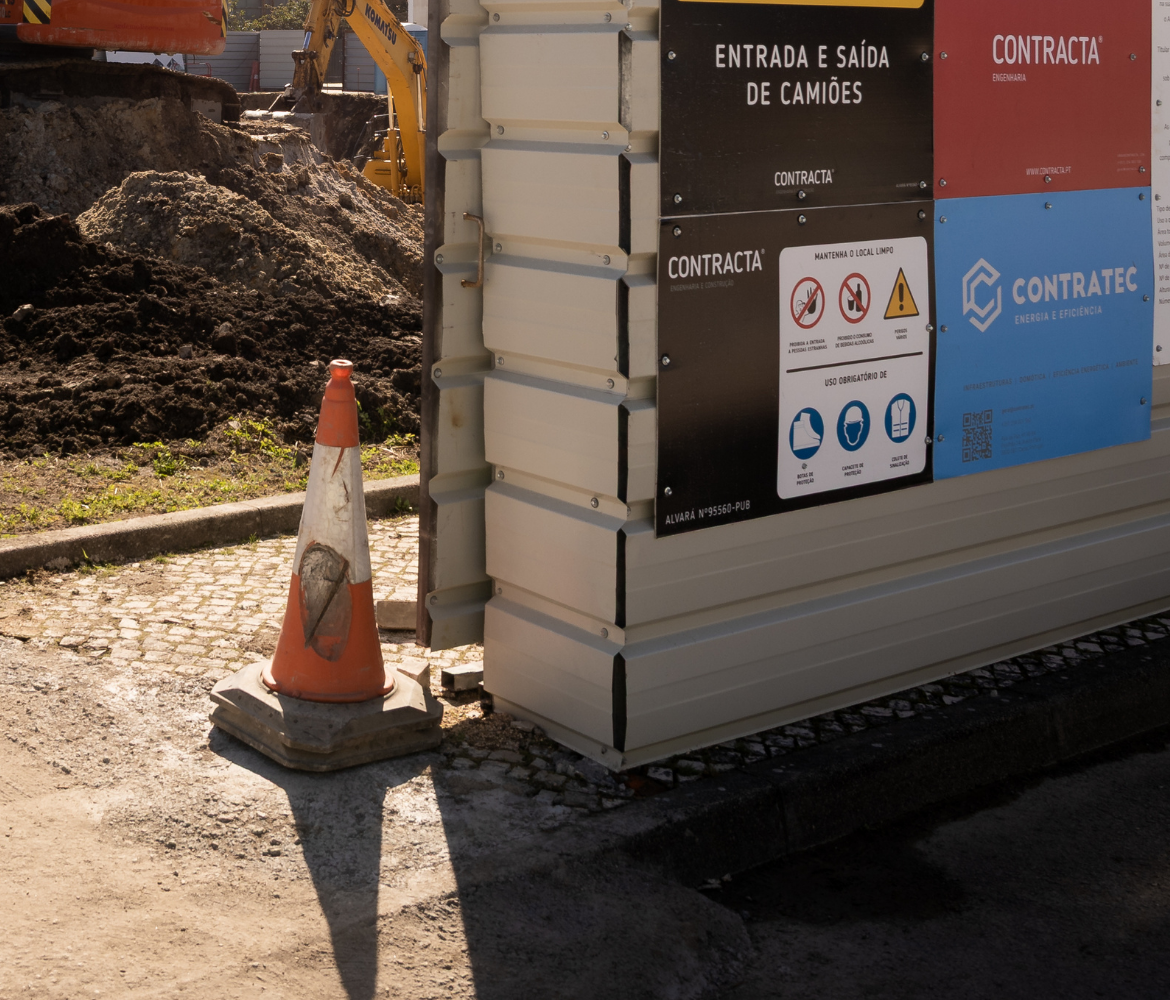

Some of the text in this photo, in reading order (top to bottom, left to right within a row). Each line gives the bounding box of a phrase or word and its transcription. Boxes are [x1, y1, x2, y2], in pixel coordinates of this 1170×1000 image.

[365, 3, 397, 45] KOMATSU
[715, 39, 889, 68] ENTRADA E SAÍDA
[992, 73, 1026, 82] ENGENHARIA
[747, 76, 862, 105] DE CAMIÕES
[1026, 166, 1072, 176] WWW.CONTRACTA.PT
[815, 251, 848, 260] MANTENHA
[856, 248, 874, 257] LOCAL
[876, 246, 894, 255] LIMPO
[1012, 266, 1138, 305] CONTRATEC
[1015, 305, 1103, 325] ENERGIA E EFICIÊNCIA
[825, 371, 887, 386] USO OBRIGATÓRIO DE
[665, 500, 751, 525] ALVARÁ Nº95560-PUB
